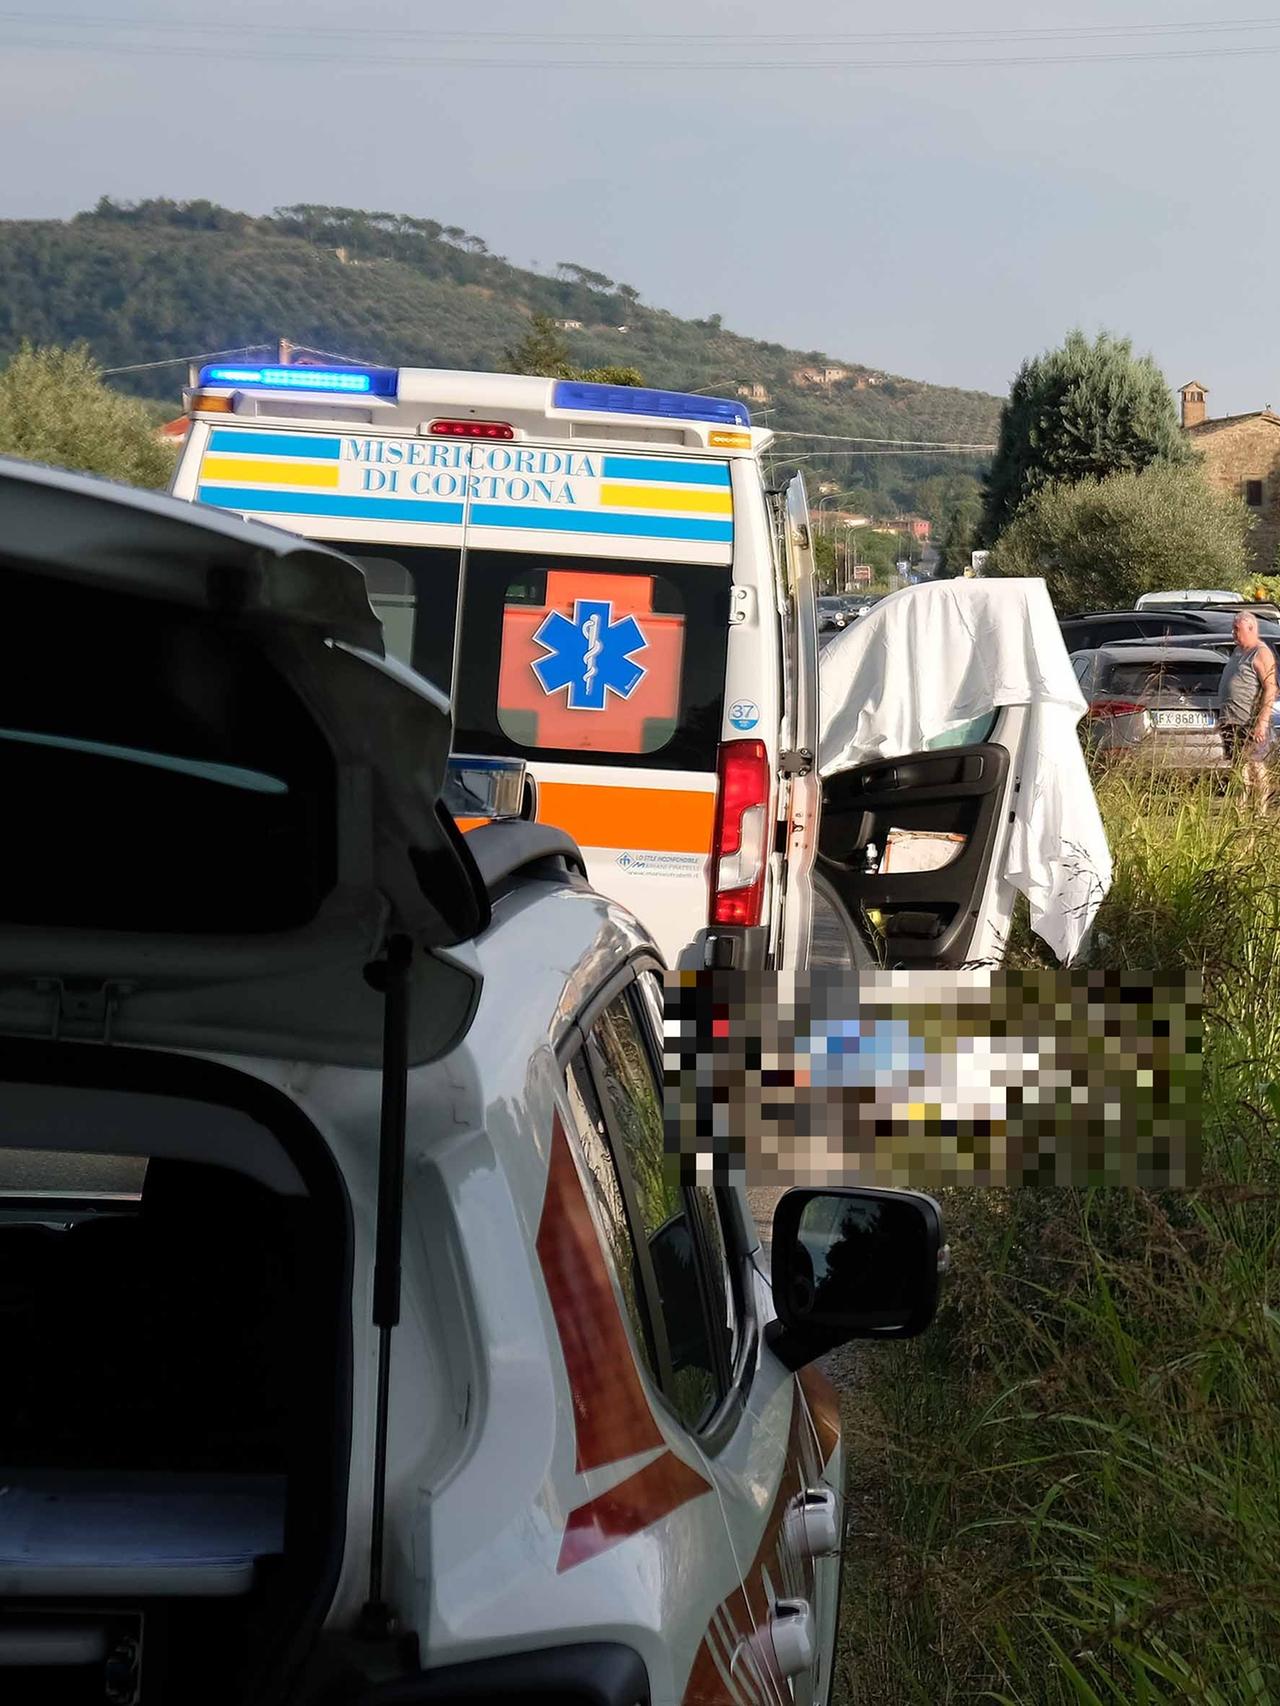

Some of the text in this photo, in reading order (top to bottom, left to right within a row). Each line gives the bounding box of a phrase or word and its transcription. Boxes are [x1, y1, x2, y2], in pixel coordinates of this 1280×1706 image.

[346, 438, 597, 478] MISERICORDIA
[362, 468, 577, 505] DI CORTONA
[732, 704, 754, 719] 37
